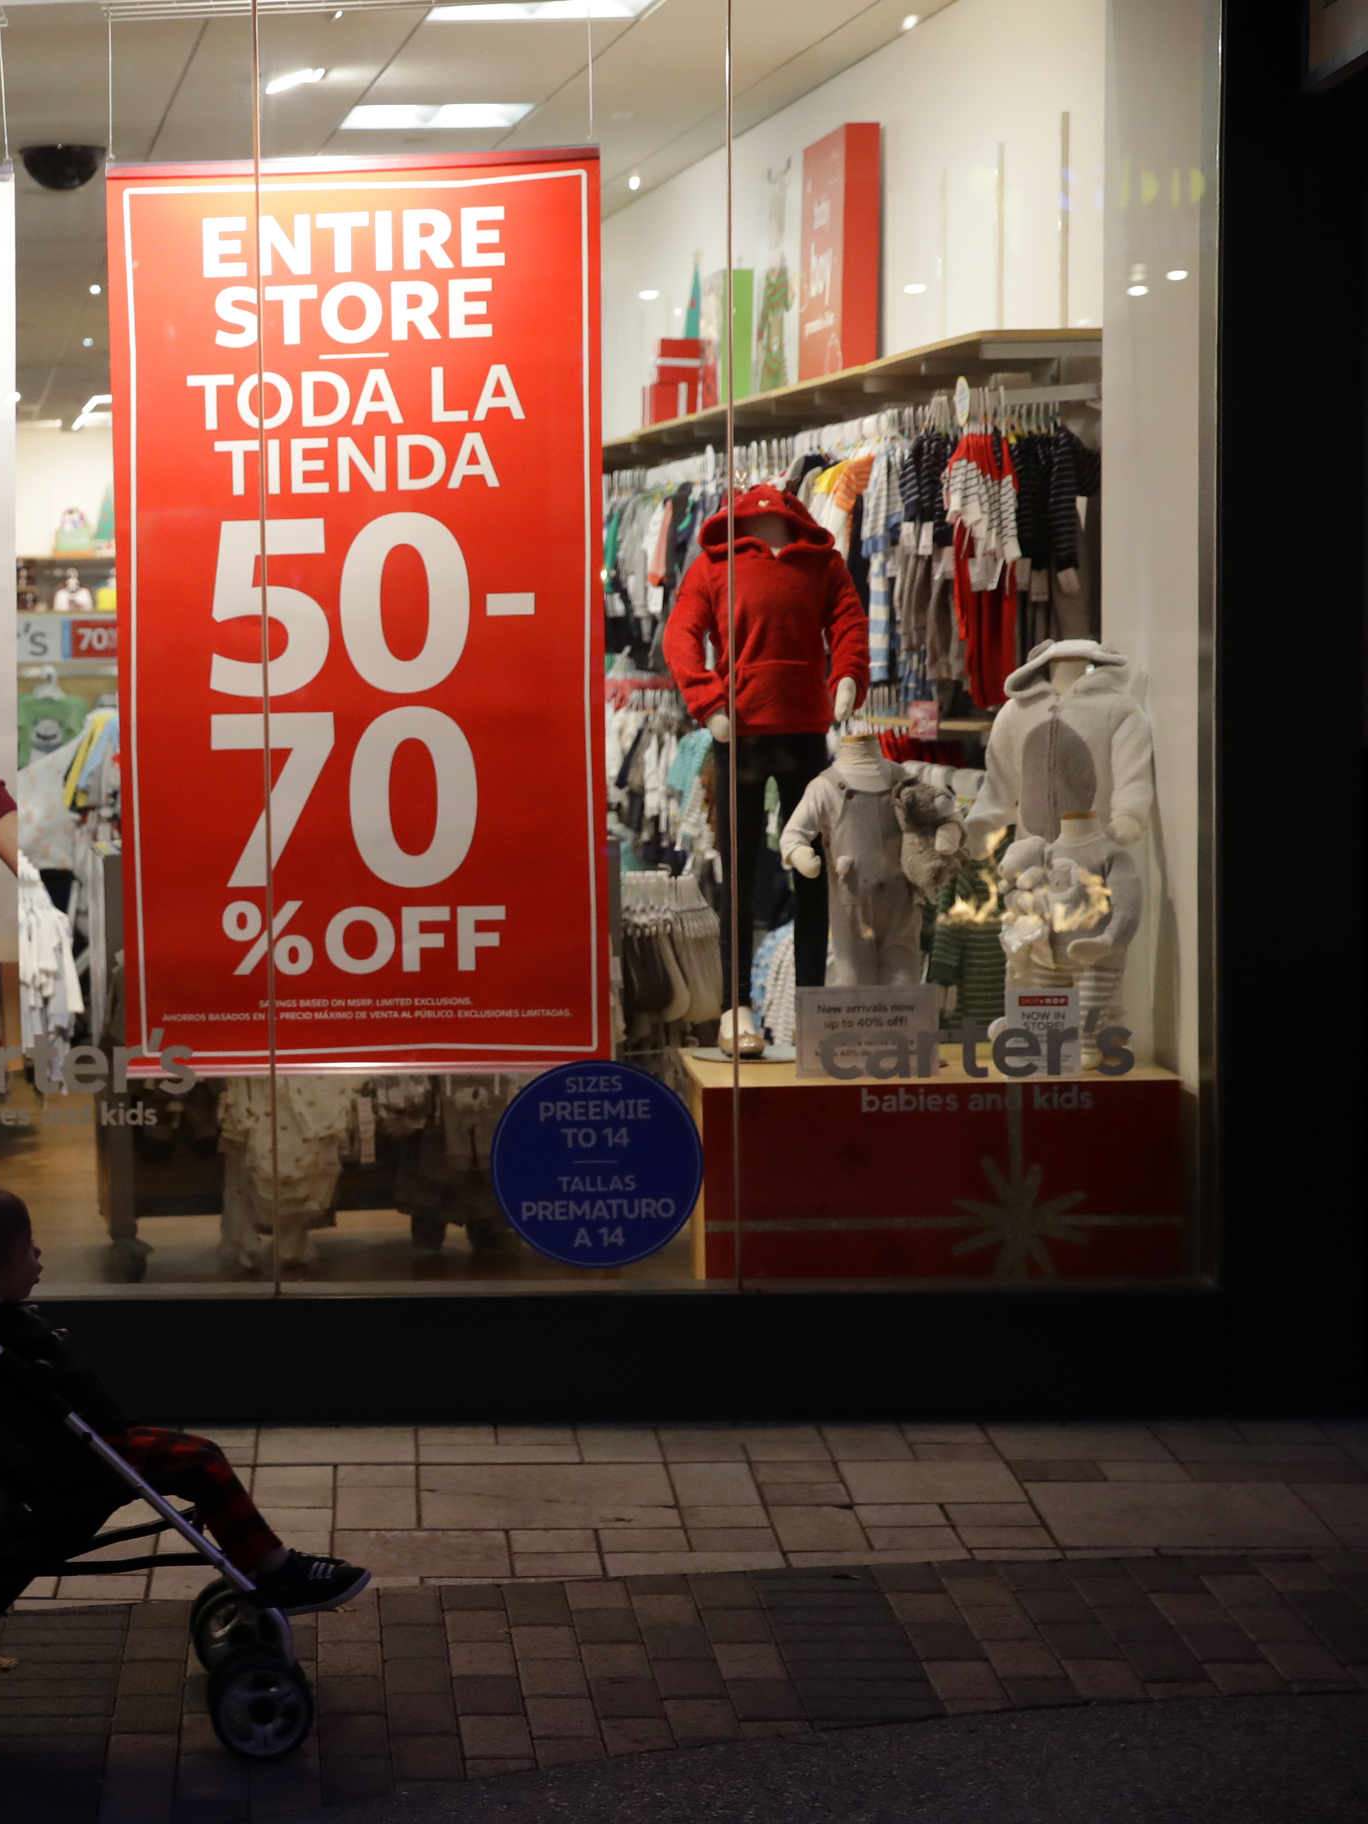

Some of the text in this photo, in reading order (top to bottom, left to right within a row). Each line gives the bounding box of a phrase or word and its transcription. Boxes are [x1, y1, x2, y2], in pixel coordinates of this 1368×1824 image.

[202, 206, 506, 278] ENTIRE
[215, 278, 493, 348] STORE
[187, 364, 525, 430] TODA LA
[214, 432, 499, 496] TIENDA
[210, 706, 477, 887] 70
[259, 1000, 297, 1008] SAINGS
[299, 999, 329, 1008] BASED
[331, 999, 345, 1007] ON
[376, 998, 412, 1006] LIMITED
[817, 1002, 916, 1014] New arrivals now
[162, 1013, 206, 1021] AHORROS
[208, 1012, 251, 1021] BASADOS
[253, 1012, 266, 1020] EN
[280, 1011, 312, 1020] PRECIO
[314, 1009, 353, 1019] MÁXIMO
[355, 1011, 367, 1019] DE
[370, 1010, 399, 1019] VENTA
[401, 1010, 412, 1018] AL
[457, 1008, 520, 1018] EXCLUSIONES
[824, 1020, 839, 1029] up
[841, 1018, 854, 1028] to
[857, 1017, 883, 1027] 40%
[1021, 1011, 1066, 1020] NOW IN
[819, 1008, 1136, 1080] carter's
[565, 1076, 623, 1093] SIZES
[861, 1084, 1093, 1113] babies and kids
[39, 1103, 92, 1126] and
[101, 1101, 158, 1126] kids
[539, 1099, 651, 1121] PREEMIE
[561, 1127, 630, 1148] TO 14
[558, 1175, 636, 1192] TALLAS
[521, 1199, 675, 1221] PREMATURO
[574, 1227, 625, 1247] A 14
